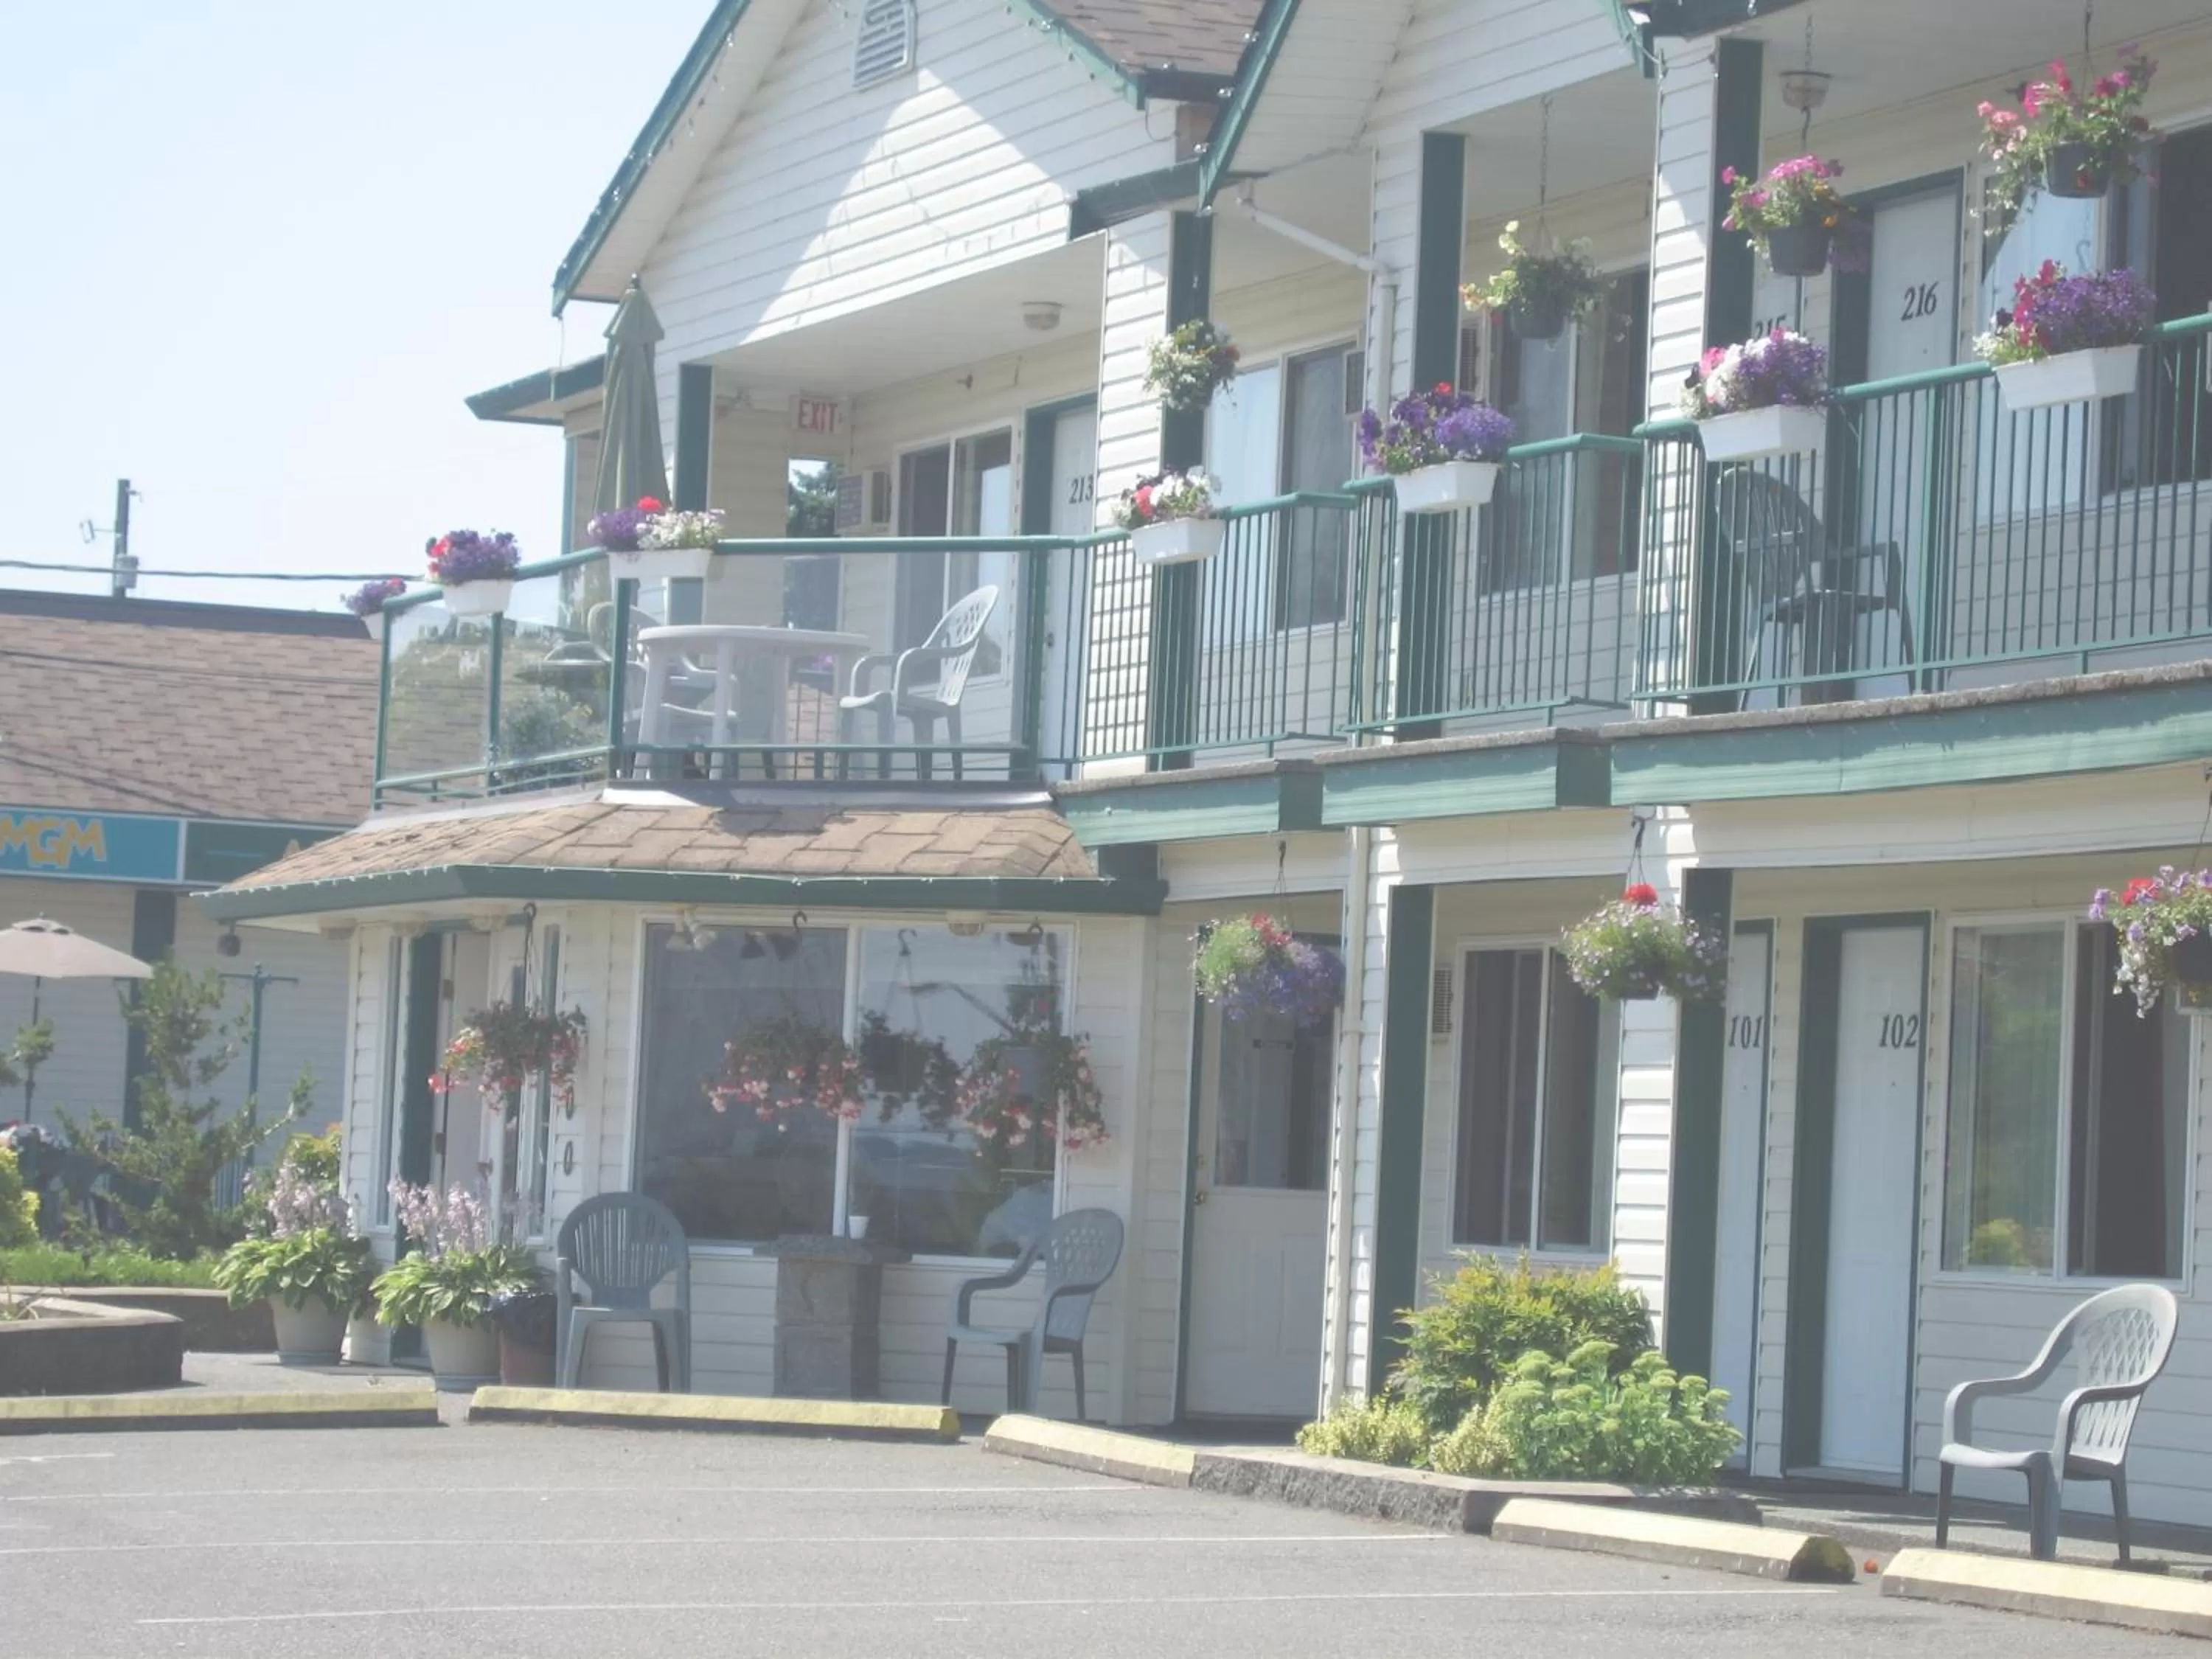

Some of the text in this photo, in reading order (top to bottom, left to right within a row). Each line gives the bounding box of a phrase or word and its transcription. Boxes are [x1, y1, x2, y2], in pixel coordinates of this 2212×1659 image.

[1901, 281, 1939, 321] 216
[799, 399, 838, 433] EXIT
[1068, 474, 1093, 504] 213
[0, 814, 107, 869] MGM
[1728, 1015, 1763, 1049] 101
[1879, 1014, 1919, 1049] 102
